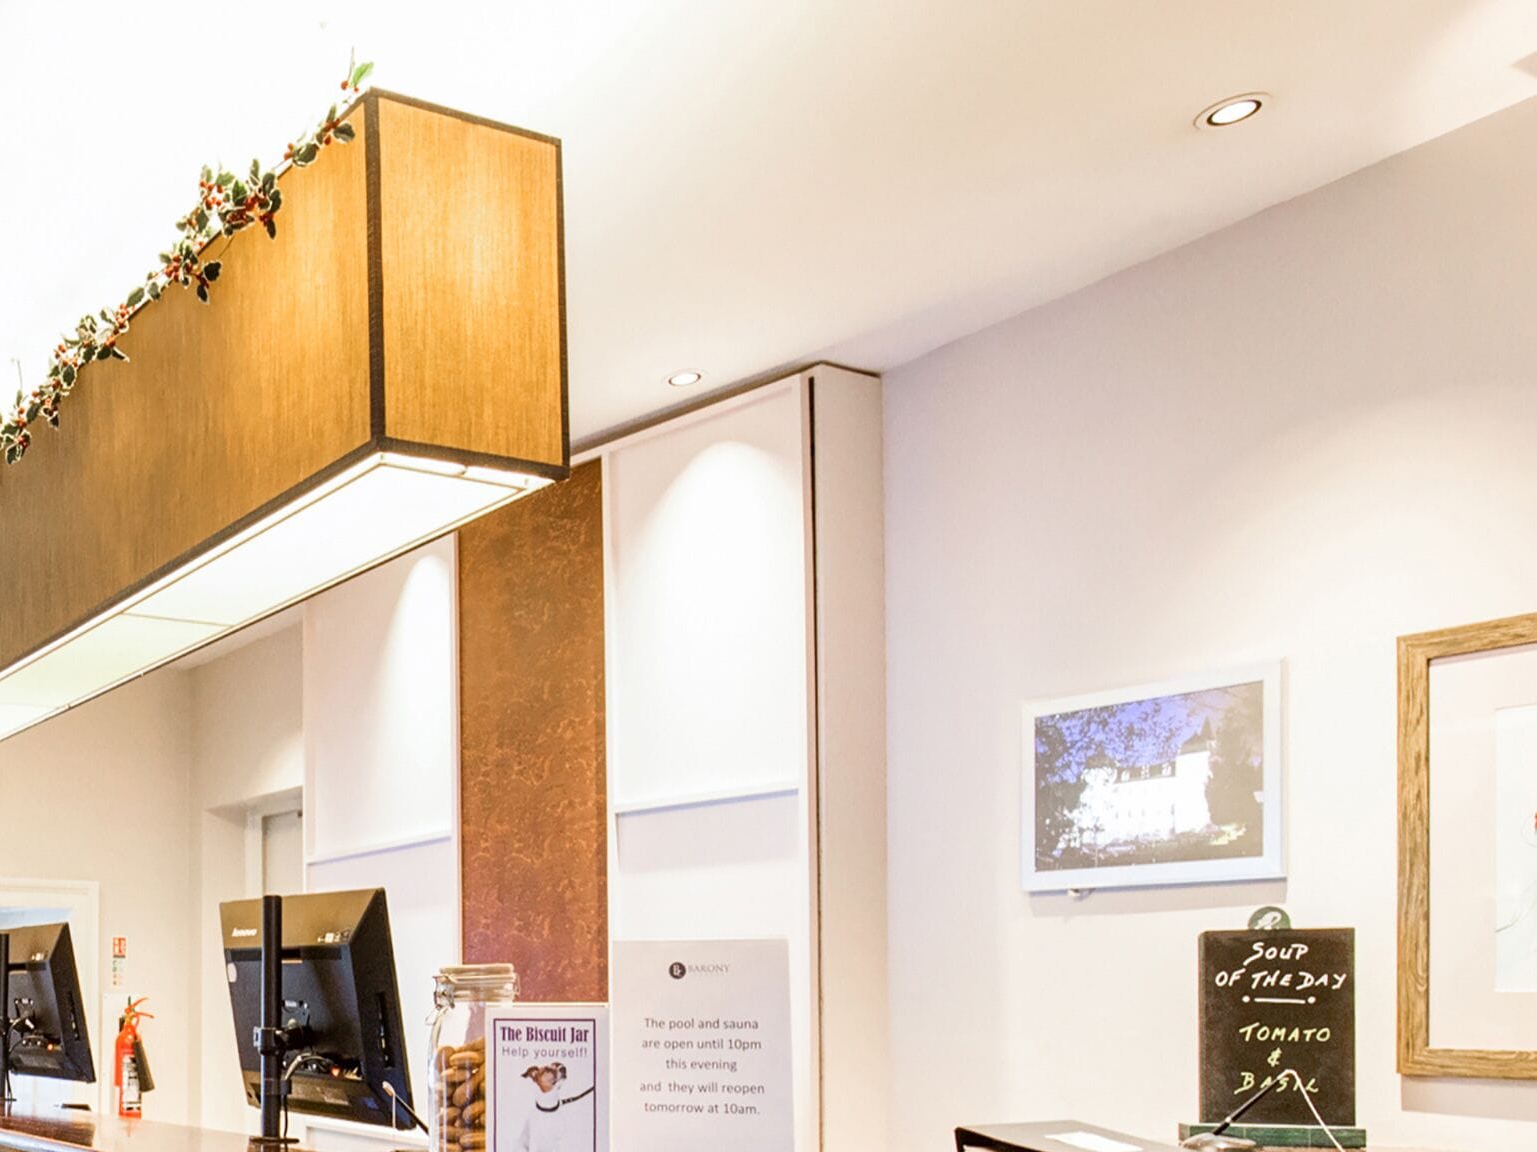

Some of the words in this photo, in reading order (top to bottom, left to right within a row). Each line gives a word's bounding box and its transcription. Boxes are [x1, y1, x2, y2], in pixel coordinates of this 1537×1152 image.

[1243, 941, 1309, 966] SOUP
[1215, 968, 1246, 987] OF
[1251, 971, 1293, 989] THE
[1296, 972, 1347, 990] DAY
[644, 1018, 665, 1030] The
[669, 1018, 694, 1031] pool
[697, 1018, 719, 1029] and
[722, 1019, 759, 1029] sauna
[500, 1026, 522, 1042] The
[526, 1026, 566, 1042] Biscuit
[569, 1027, 589, 1044] Jar
[1239, 1022, 1331, 1042] TOMATO
[642, 1039, 661, 1049] are
[665, 1039, 694, 1051] open
[697, 1038, 724, 1049] until
[728, 1038, 761, 1051] 10pm
[502, 1046, 530, 1058] Help
[534, 1046, 588, 1059] yourself!
[665, 1058, 687, 1070] this
[690, 1059, 737, 1072] evening
[640, 1081, 661, 1092] and
[669, 1081, 694, 1095] they
[697, 1082, 718, 1094] will
[722, 1084, 765, 1096] reopen
[644, 1102, 704, 1113] tomorrow
[707, 1102, 719, 1113] at
[724, 1102, 761, 1114] 10am.
